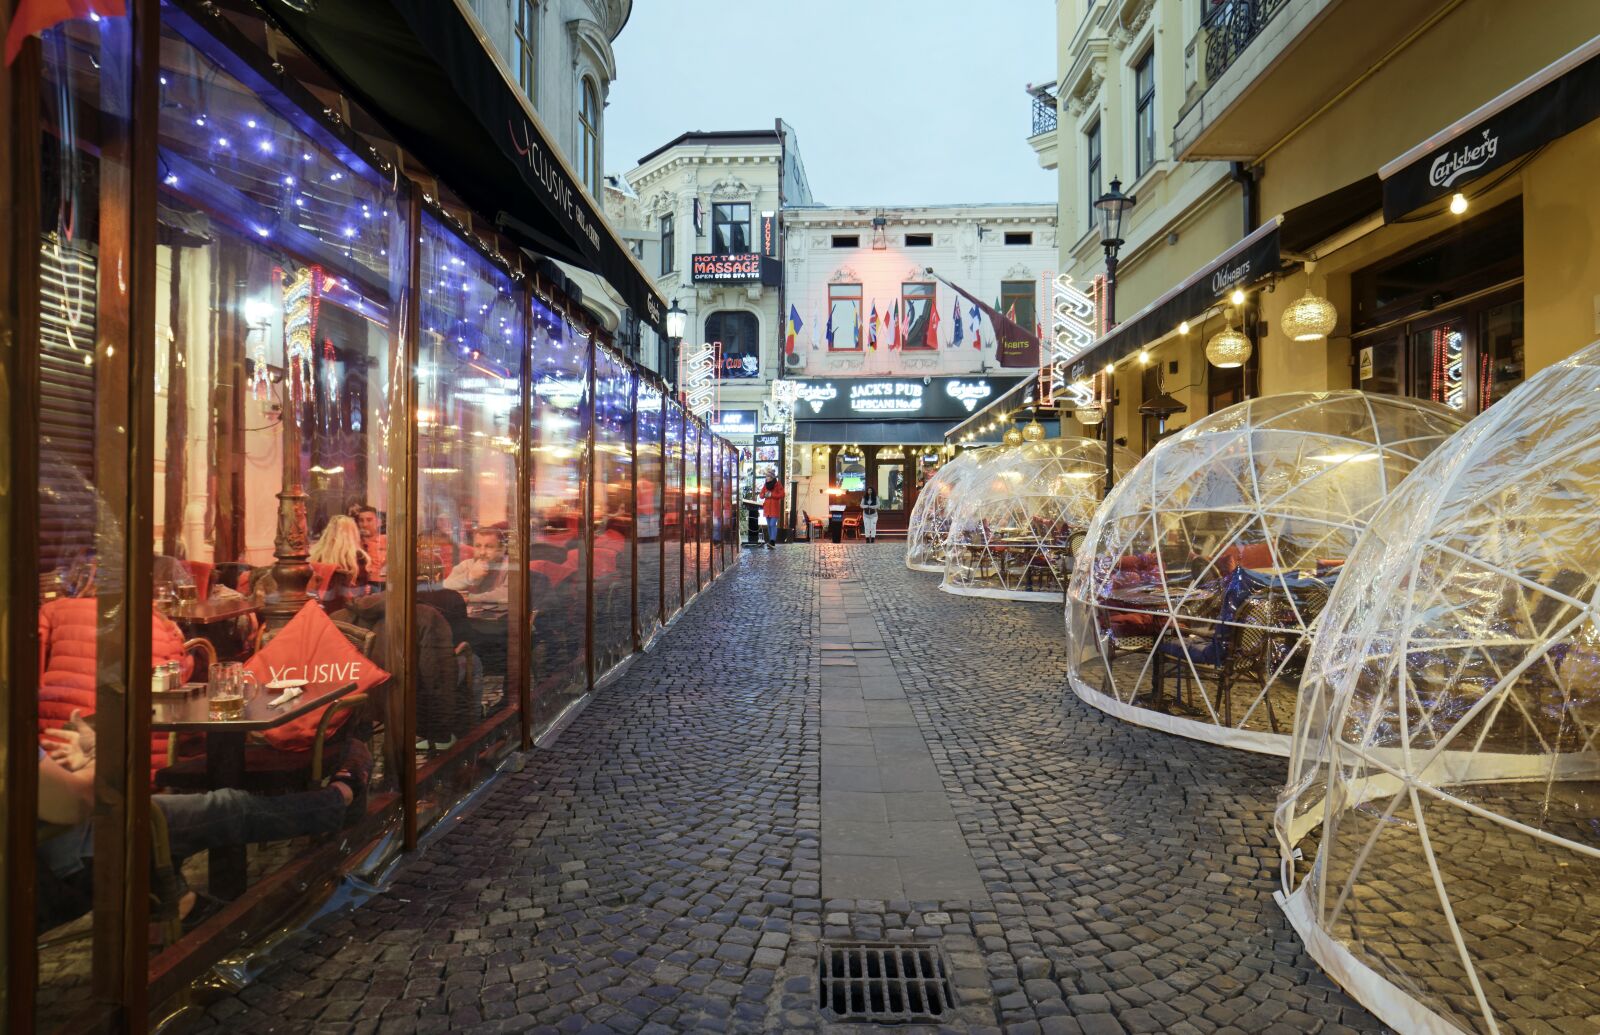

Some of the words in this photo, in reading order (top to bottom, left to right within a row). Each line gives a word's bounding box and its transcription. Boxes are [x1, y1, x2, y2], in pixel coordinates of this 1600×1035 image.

[1429, 130, 1499, 187] Carlsberg
[694, 262, 759, 273] MASSAGE
[1227, 260, 1250, 284] HABITS
[795, 383, 837, 400] Carlsberg
[850, 384, 892, 398] JACK'S
[895, 384, 922, 396] PUB
[946, 381, 991, 400] Carlsberg
[851, 399, 894, 408] LIPSCANI
[723, 414, 742, 423] ART
[269, 662, 361, 683] XCUSIVE
